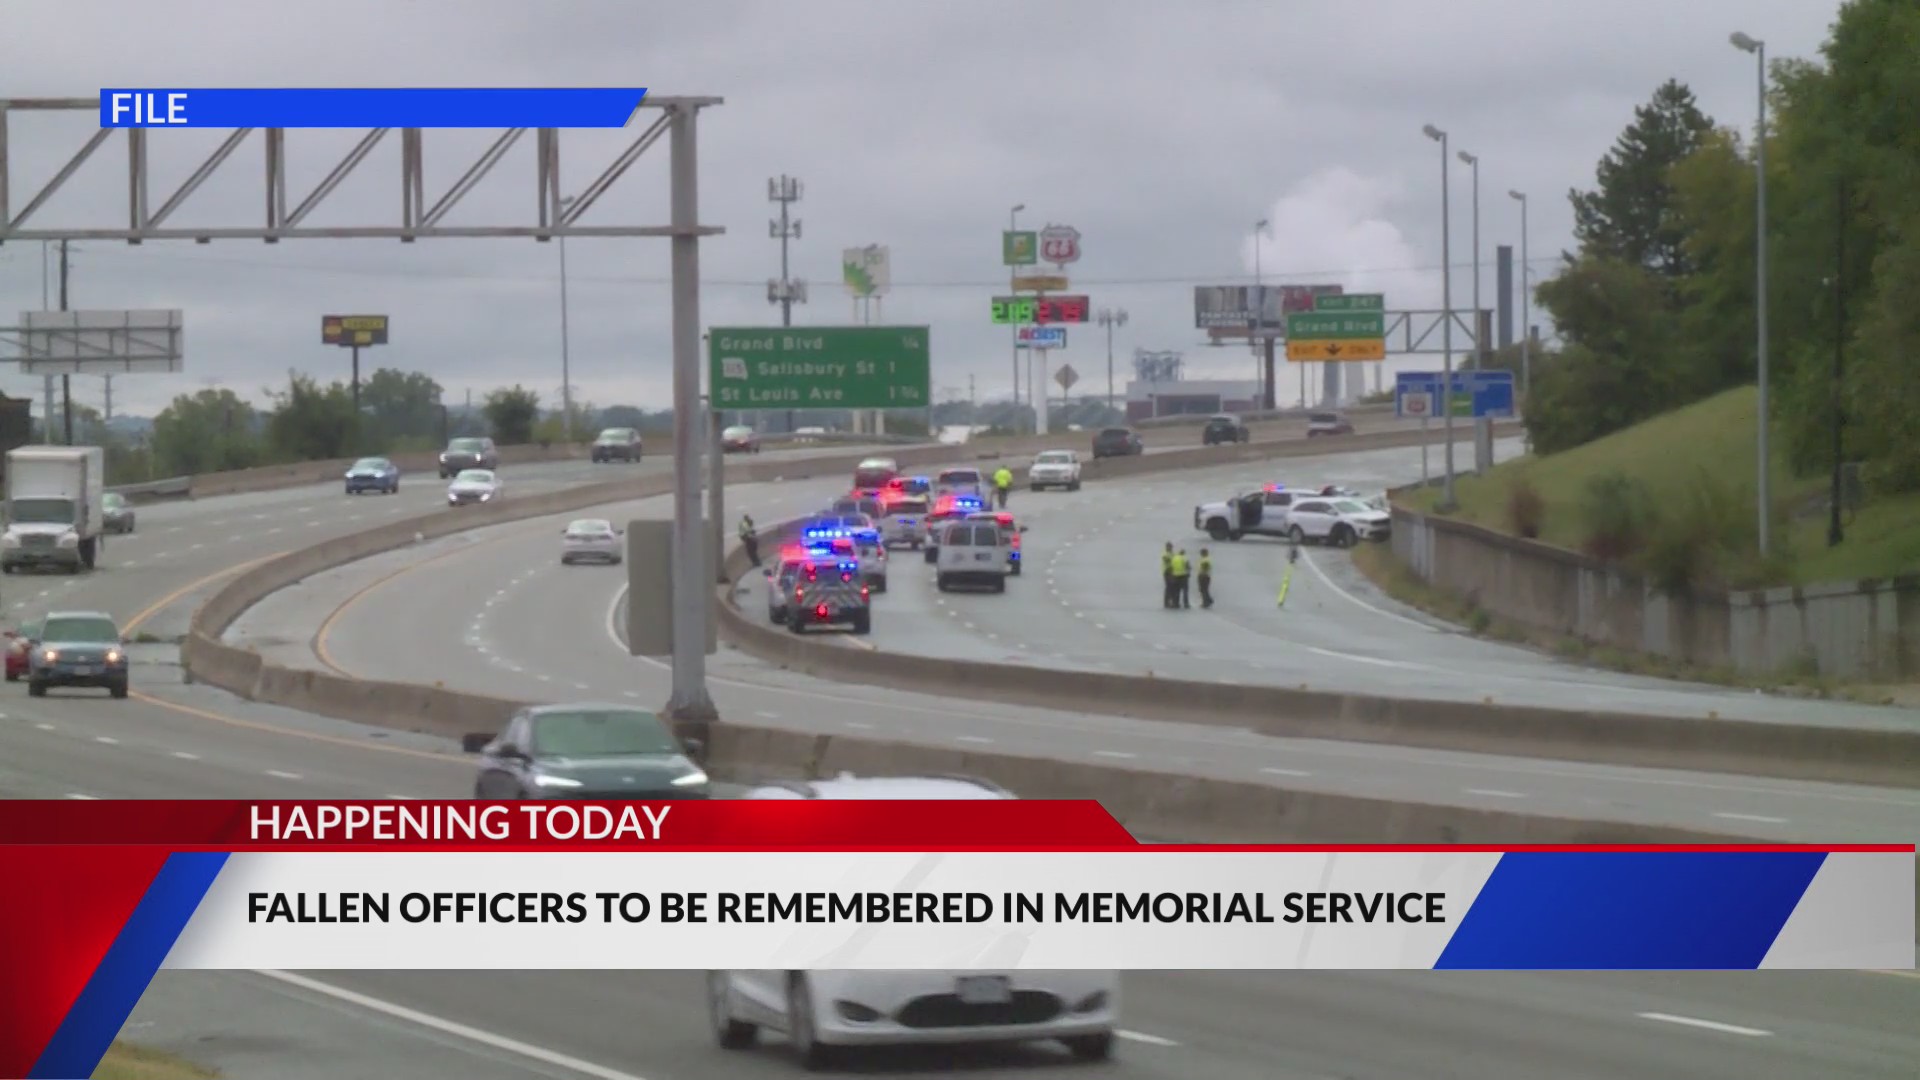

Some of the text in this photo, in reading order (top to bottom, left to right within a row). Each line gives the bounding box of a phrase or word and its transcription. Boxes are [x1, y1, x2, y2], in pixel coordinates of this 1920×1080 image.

[1295, 320, 1378, 332] Grand Blvd
[720, 337, 774, 350] Grand
[783, 336, 823, 350] Blvd
[758, 361, 846, 377] Salisbury
[856, 360, 875, 375] St
[889, 360, 896, 374] 1
[720, 387, 740, 401] St
[749, 387, 799, 401] Louis
[810, 386, 843, 400] Ave
